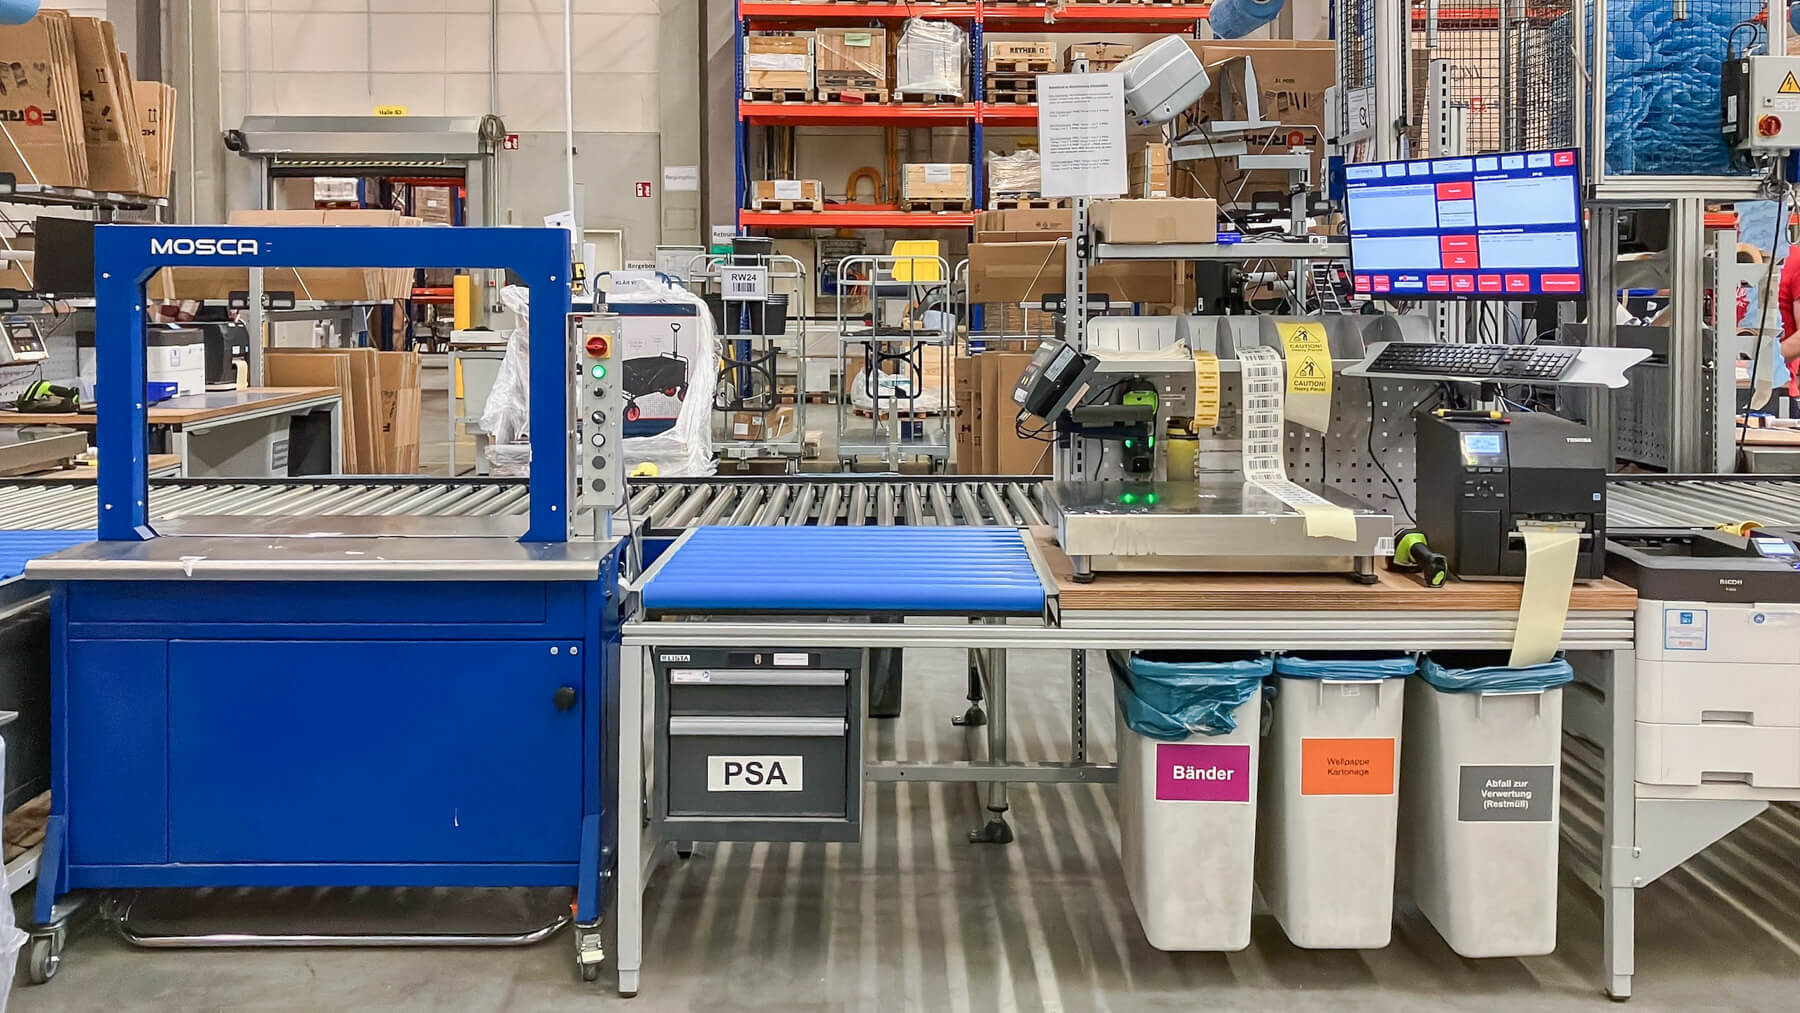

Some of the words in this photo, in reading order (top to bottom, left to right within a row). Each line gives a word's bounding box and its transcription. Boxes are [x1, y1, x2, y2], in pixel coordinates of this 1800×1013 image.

[151, 238, 258, 255] MOSCA
[724, 761, 788, 786] PSA
[1173, 765, 1234, 780] Bänder
[1485, 779, 1512, 788] Abfall
[1481, 790, 1532, 799] Verwertung
[1483, 800, 1529, 810] (Restmüll)
